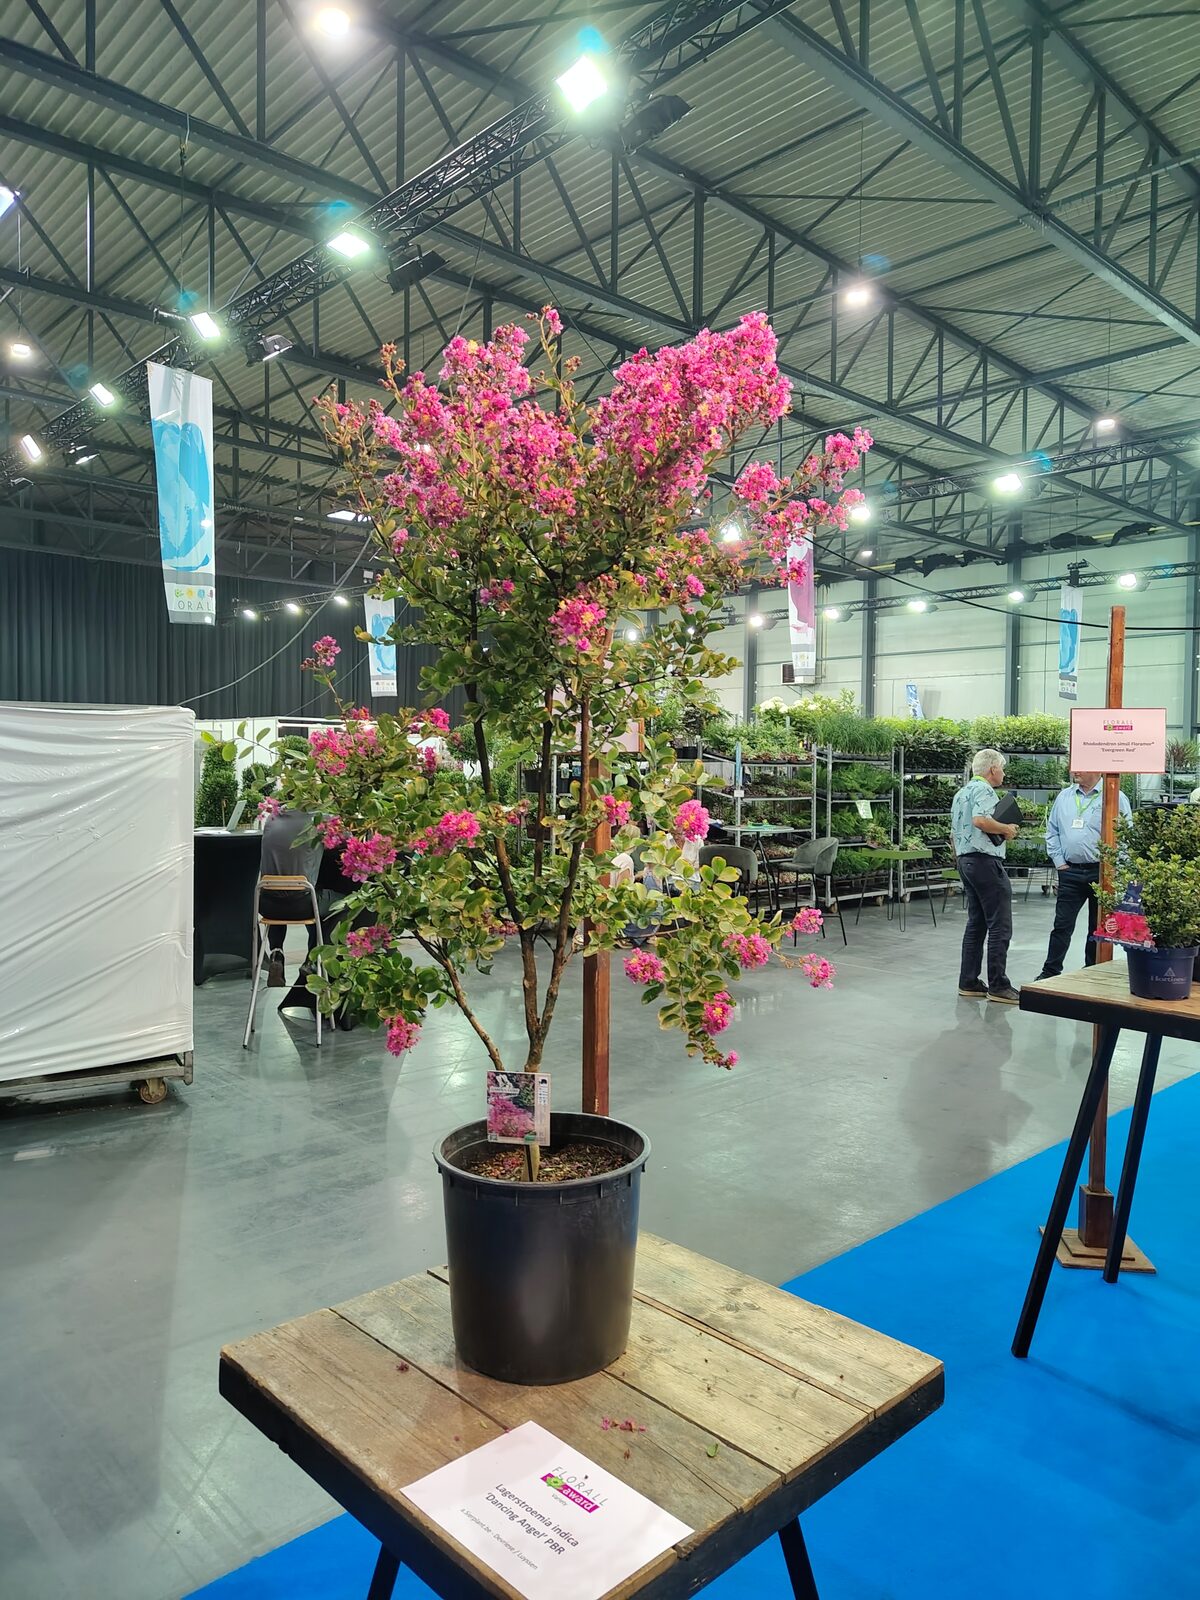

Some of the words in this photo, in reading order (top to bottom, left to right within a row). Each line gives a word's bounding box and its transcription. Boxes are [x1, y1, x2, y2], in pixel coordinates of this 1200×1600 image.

[552, 1466, 608, 1506] FLORALL
[562, 1486, 594, 1511] award
[495, 1483, 553, 1527] Lagerstroemia
[551, 1524, 579, 1547] indica
[544, 1538, 566, 1555] PBR
